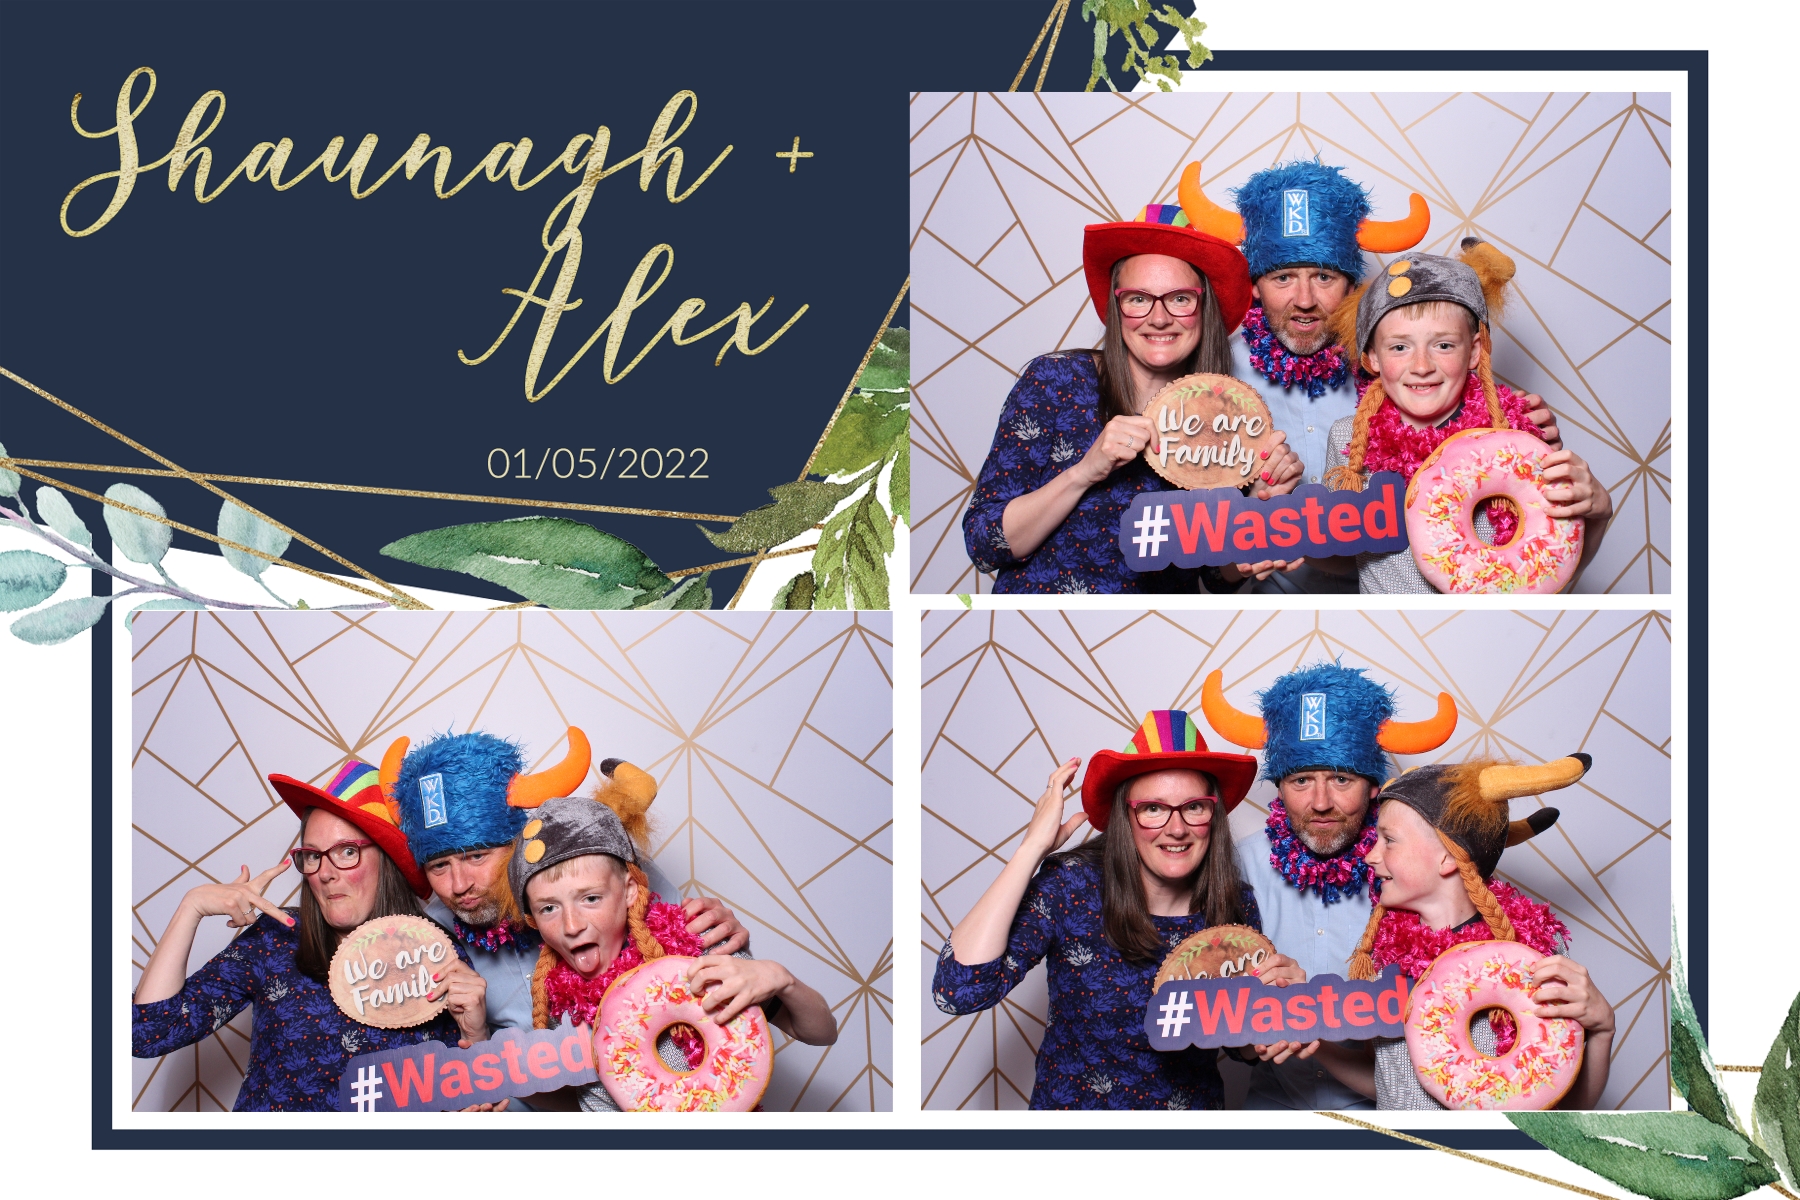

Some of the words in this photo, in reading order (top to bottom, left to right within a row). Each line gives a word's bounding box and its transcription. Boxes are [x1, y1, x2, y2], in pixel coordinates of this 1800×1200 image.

[1158, 398, 1204, 436] We
[1212, 412, 1267, 437] are
[1158, 434, 1257, 477] Family
[1132, 483, 1399, 558] #Wasted
[343, 949, 387, 985] We
[395, 941, 447, 970] are
[1156, 975, 1408, 1038] #Wasted
[350, 1023, 594, 1112] #Wasted
